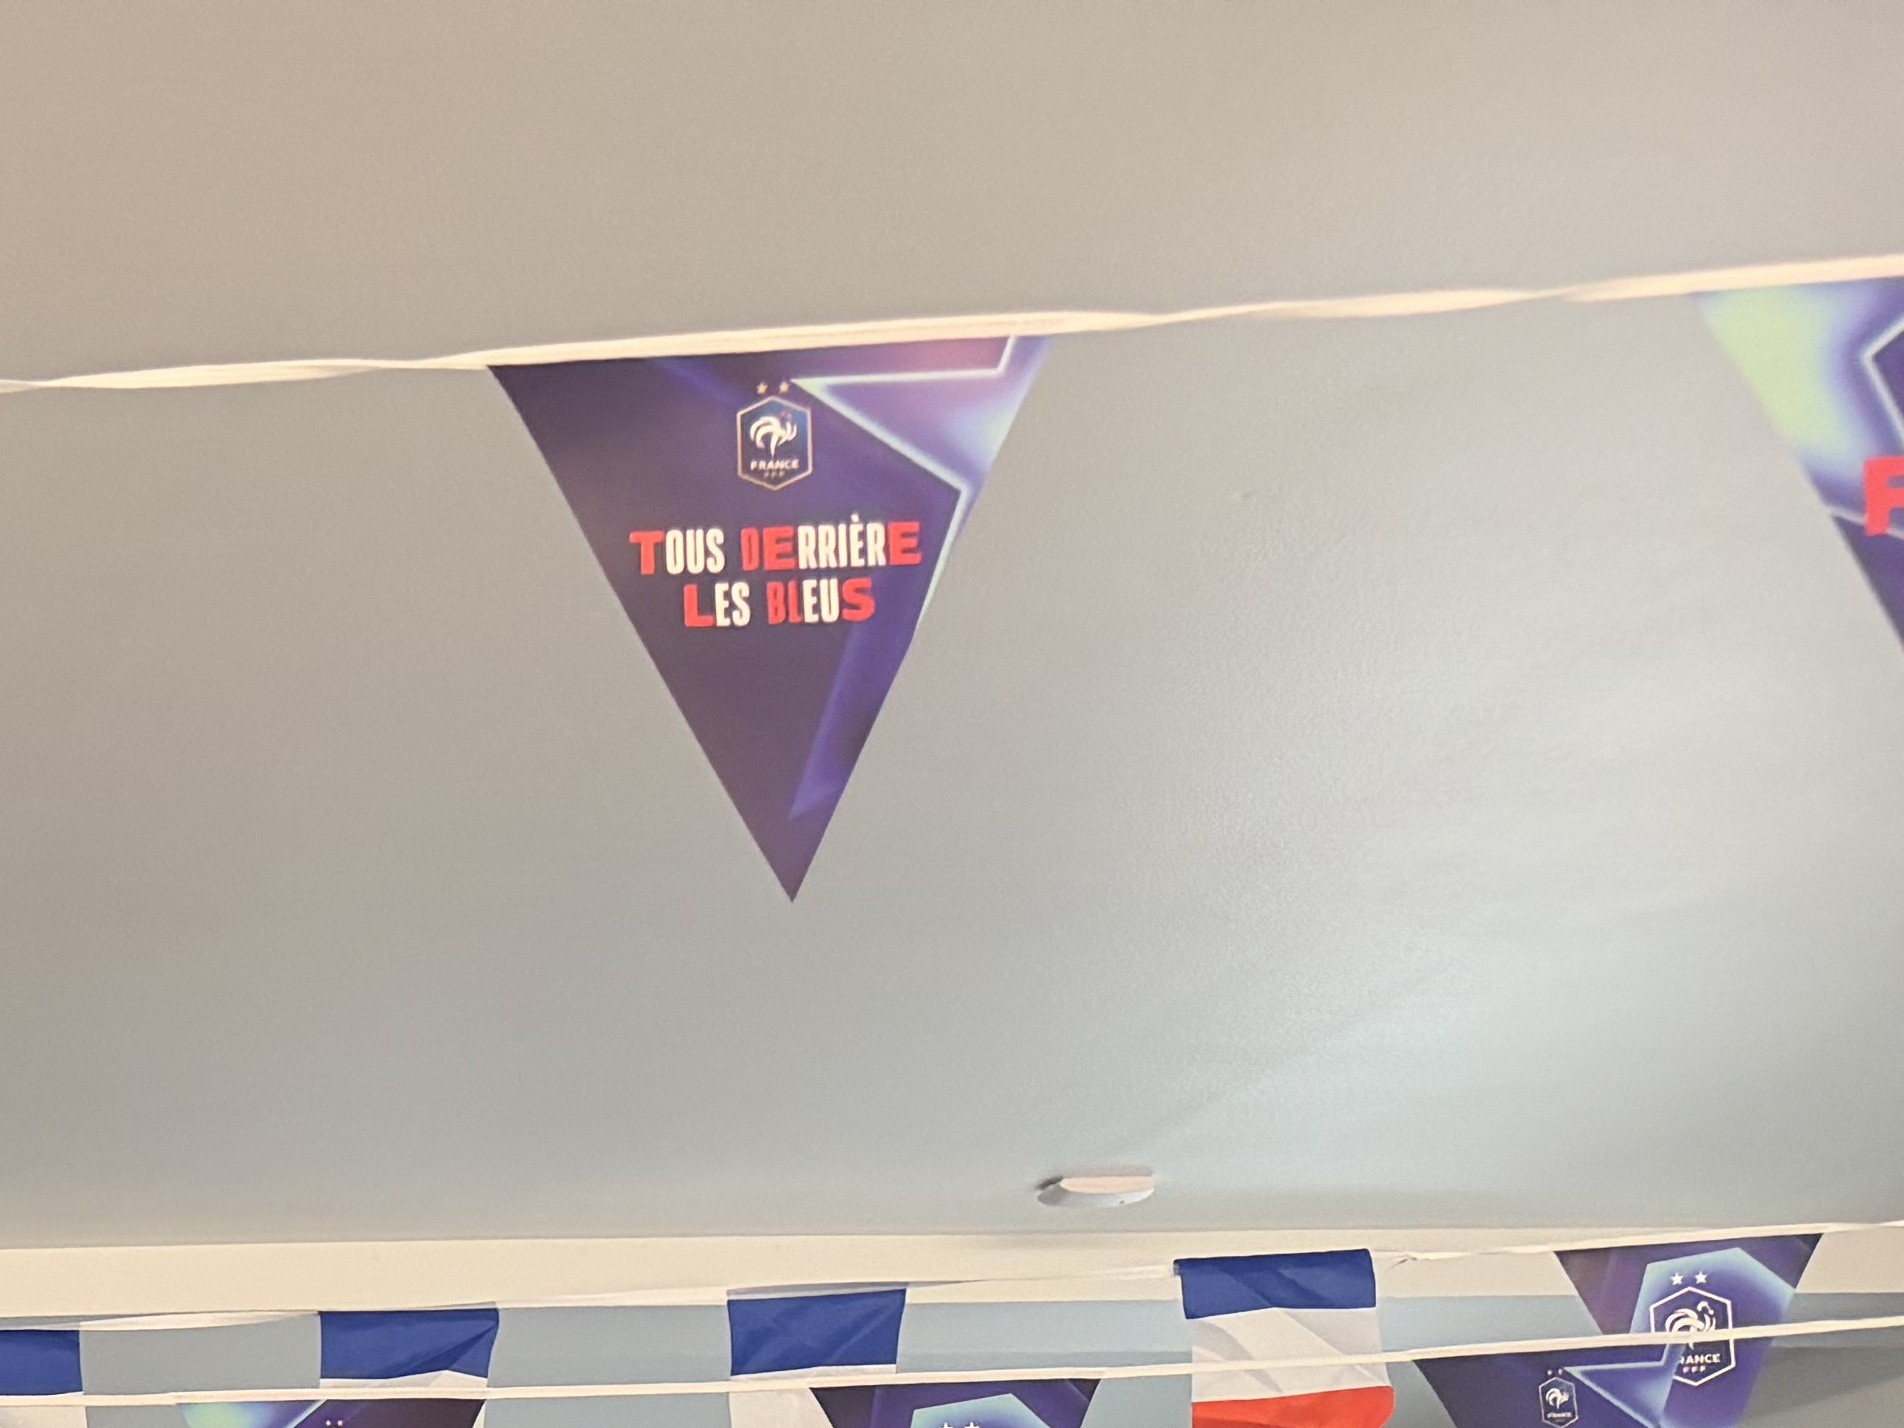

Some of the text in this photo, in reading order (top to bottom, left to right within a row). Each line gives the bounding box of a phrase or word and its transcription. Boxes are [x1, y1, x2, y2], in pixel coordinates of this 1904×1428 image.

[629, 512, 922, 575] TOUS DERRIÈRE
[682, 577, 876, 628] LES BLEUS
